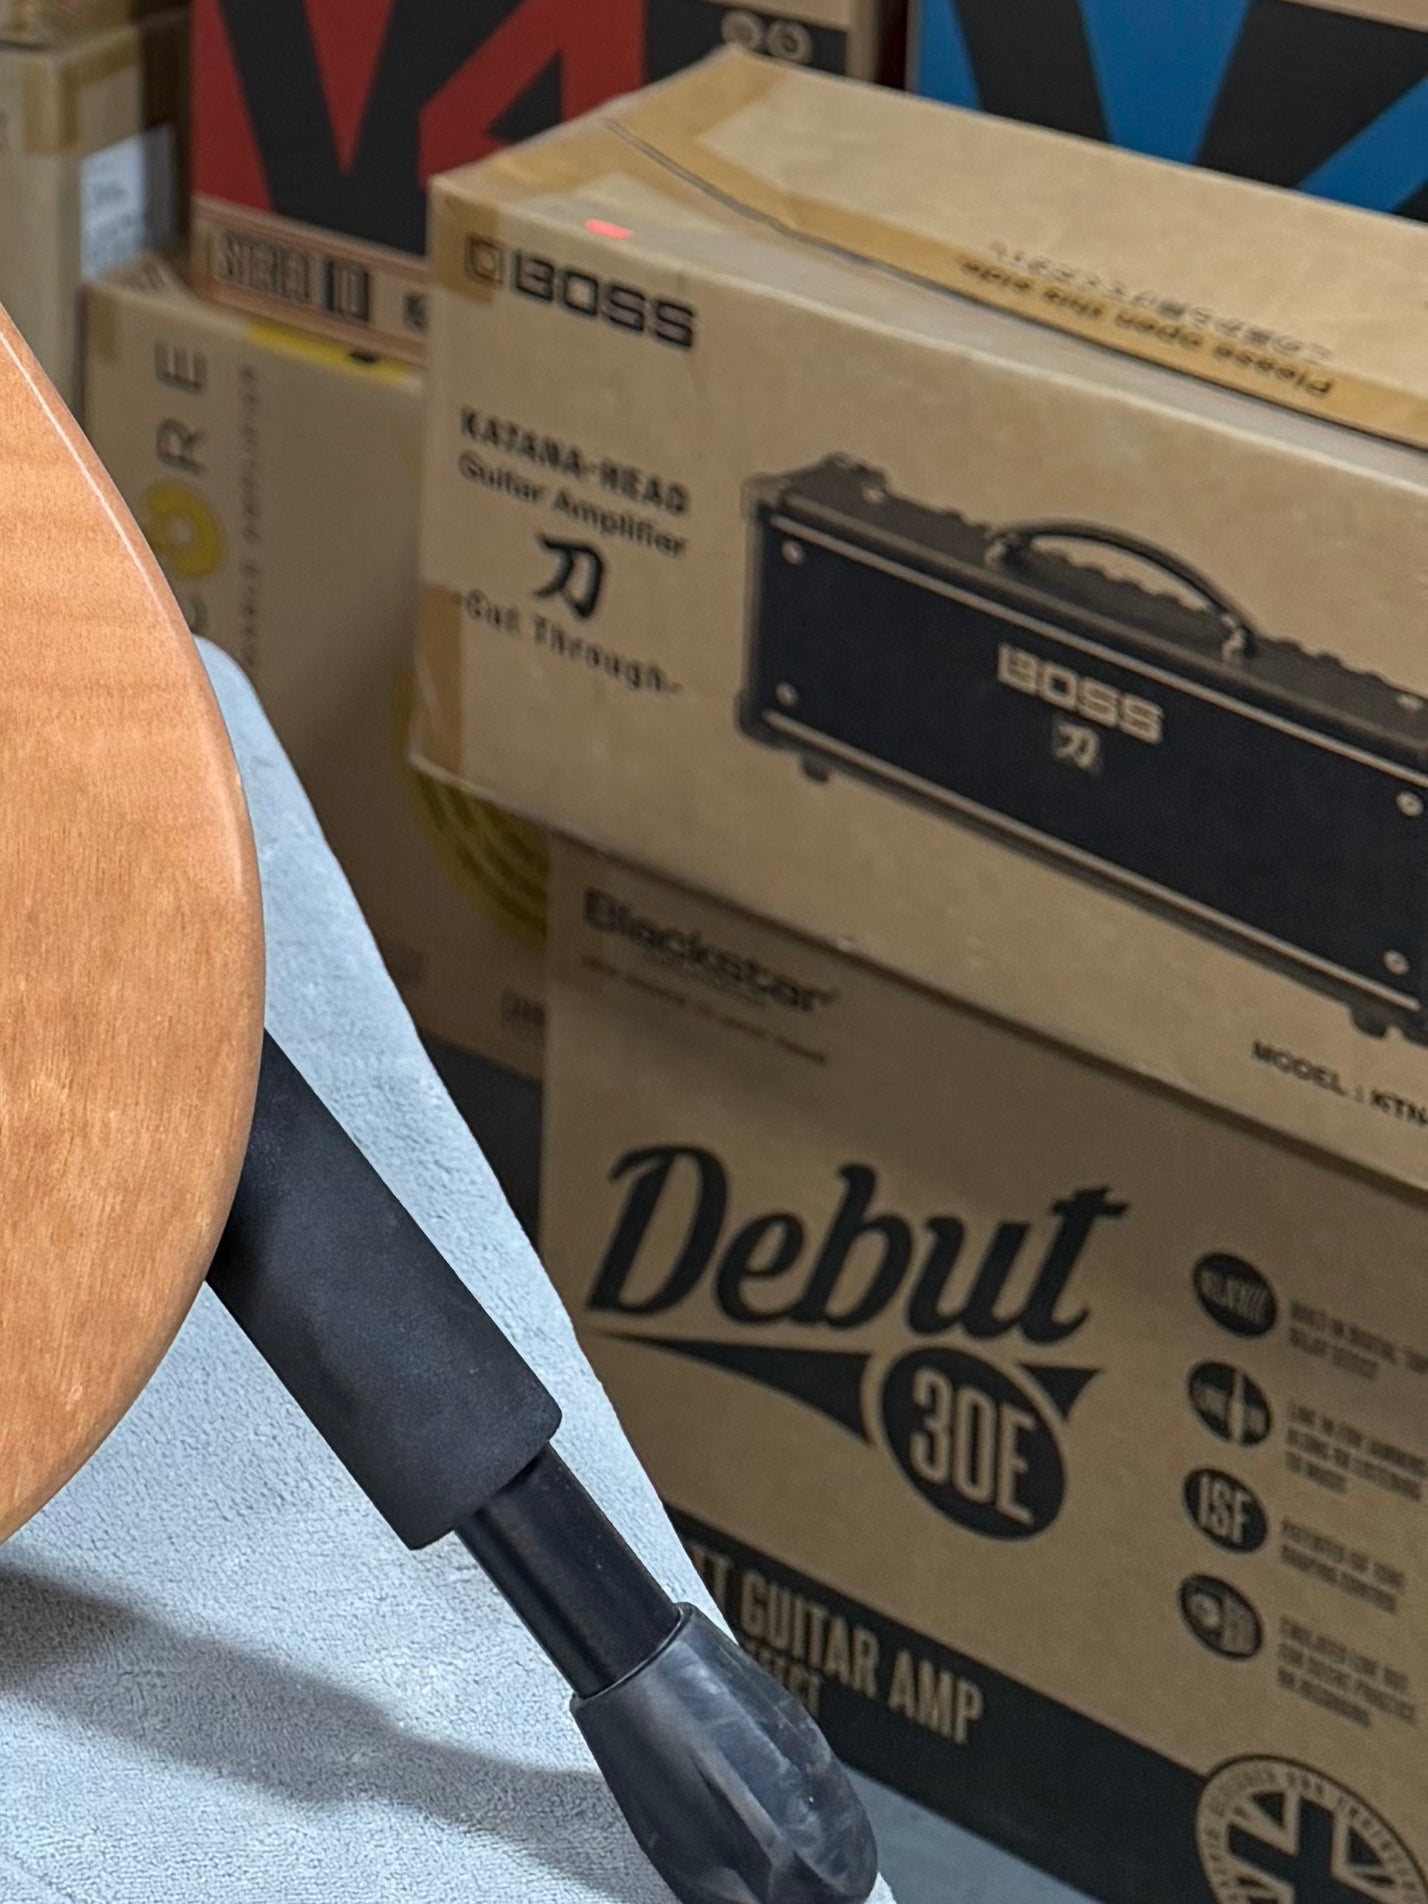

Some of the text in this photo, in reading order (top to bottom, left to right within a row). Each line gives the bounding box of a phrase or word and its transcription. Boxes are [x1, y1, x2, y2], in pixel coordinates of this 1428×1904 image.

[512, 247, 697, 351] BOSS
[459, 449, 687, 558] Guitar Amplifier
[460, 405, 690, 517] KATANA-HEAD
[997, 641, 1164, 745] BOSS
[1253, 1040, 1347, 1097] MODEL
[585, 1144, 1131, 1346] Debut
[909, 1366, 1037, 1528] 30E
[1197, 1473, 1251, 1543] ISF
[742, 1569, 880, 1700] GUITAR
[887, 1647, 984, 1743] AMP
